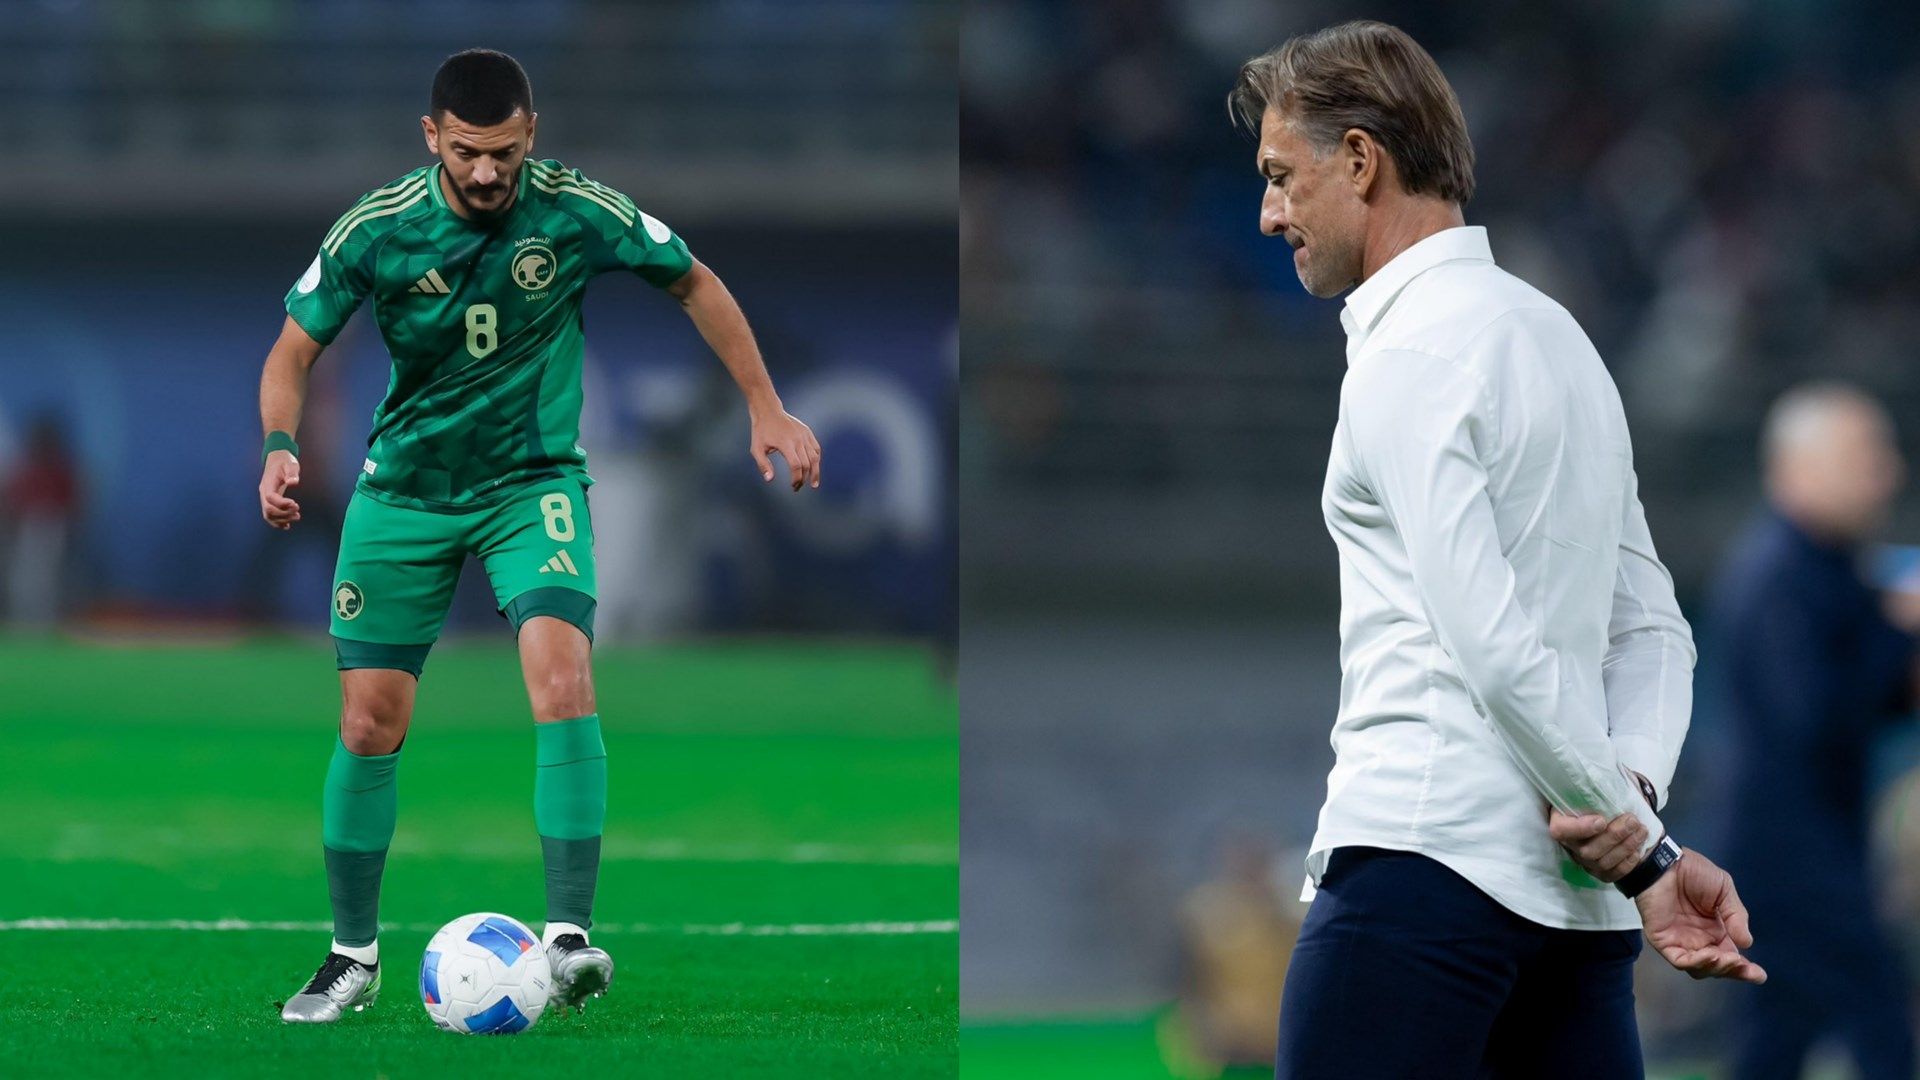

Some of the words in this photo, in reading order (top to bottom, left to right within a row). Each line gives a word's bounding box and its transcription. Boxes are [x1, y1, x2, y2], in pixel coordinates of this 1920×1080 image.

[525, 291, 549, 301] SAUDI
[465, 303, 498, 359] 8
[540, 493, 575, 542] 8
